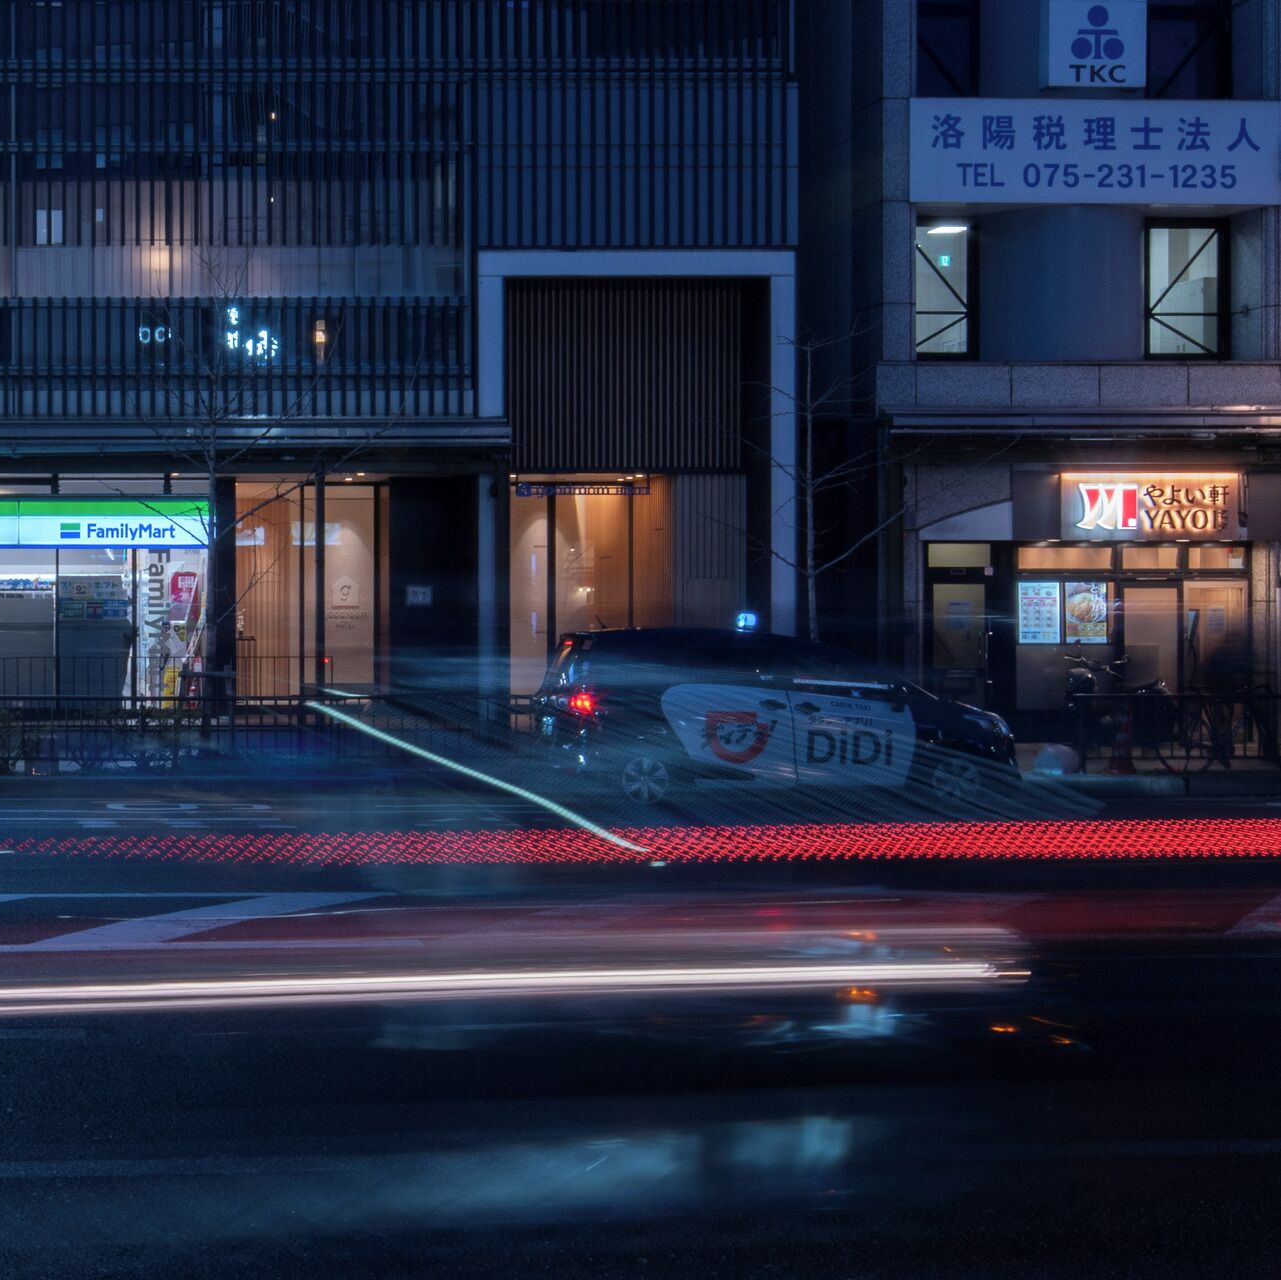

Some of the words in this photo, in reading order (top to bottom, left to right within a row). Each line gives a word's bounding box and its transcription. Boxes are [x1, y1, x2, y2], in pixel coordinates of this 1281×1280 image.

[1068, 64, 1127, 84] TKC
[931, 113, 1261, 153] 洛陽税理士法人
[956, 162, 1005, 188] TEL
[1022, 162, 1238, 190] 075-231-1235
[1143, 484, 1230, 507] やよい軒
[1144, 509, 1217, 530] YAYOI
[87, 523, 176, 541] FamilyMart
[806, 728, 893, 766] DiDi
